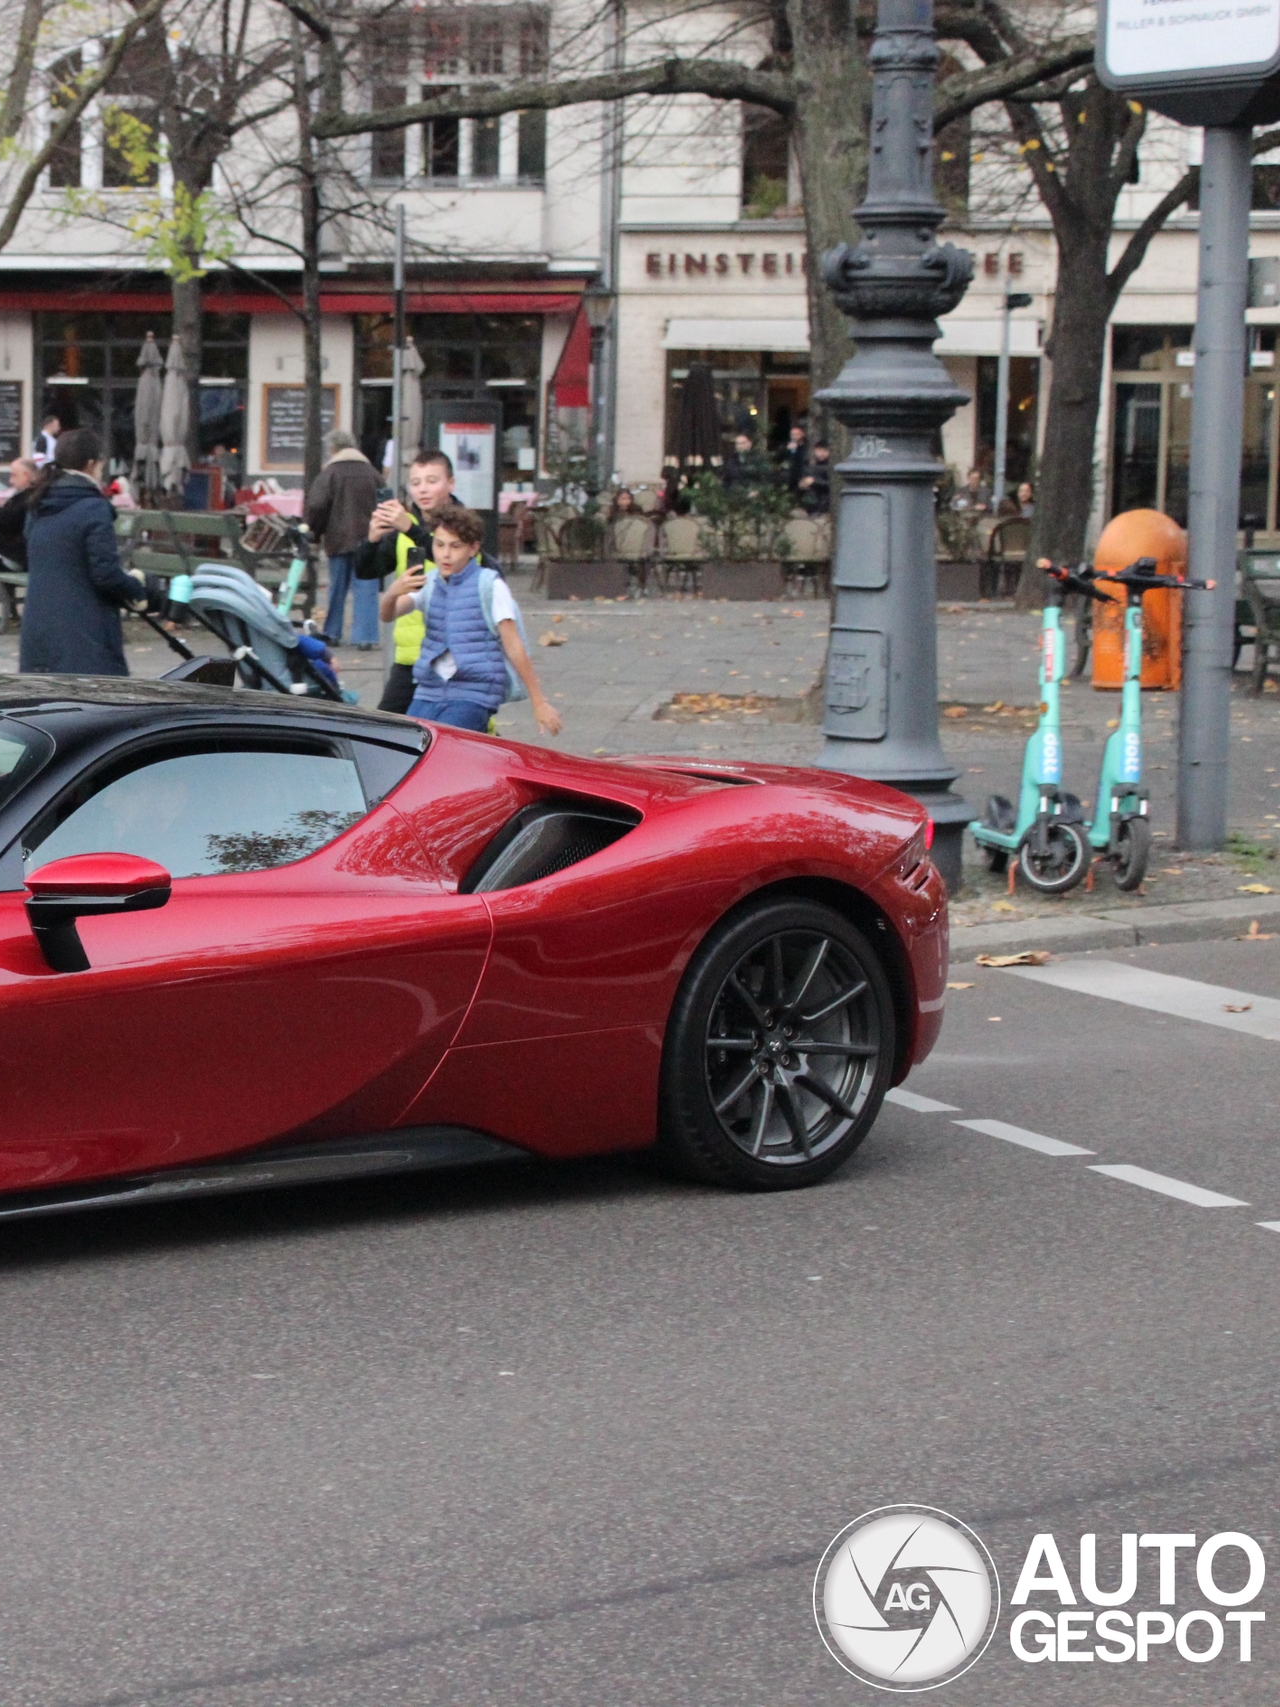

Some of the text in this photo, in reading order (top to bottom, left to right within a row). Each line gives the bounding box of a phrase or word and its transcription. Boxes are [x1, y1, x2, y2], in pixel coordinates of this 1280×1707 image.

[646, 252, 808, 276] EINSTEI
[1042, 733, 1059, 775] dott
[1124, 733, 1140, 774] dott
